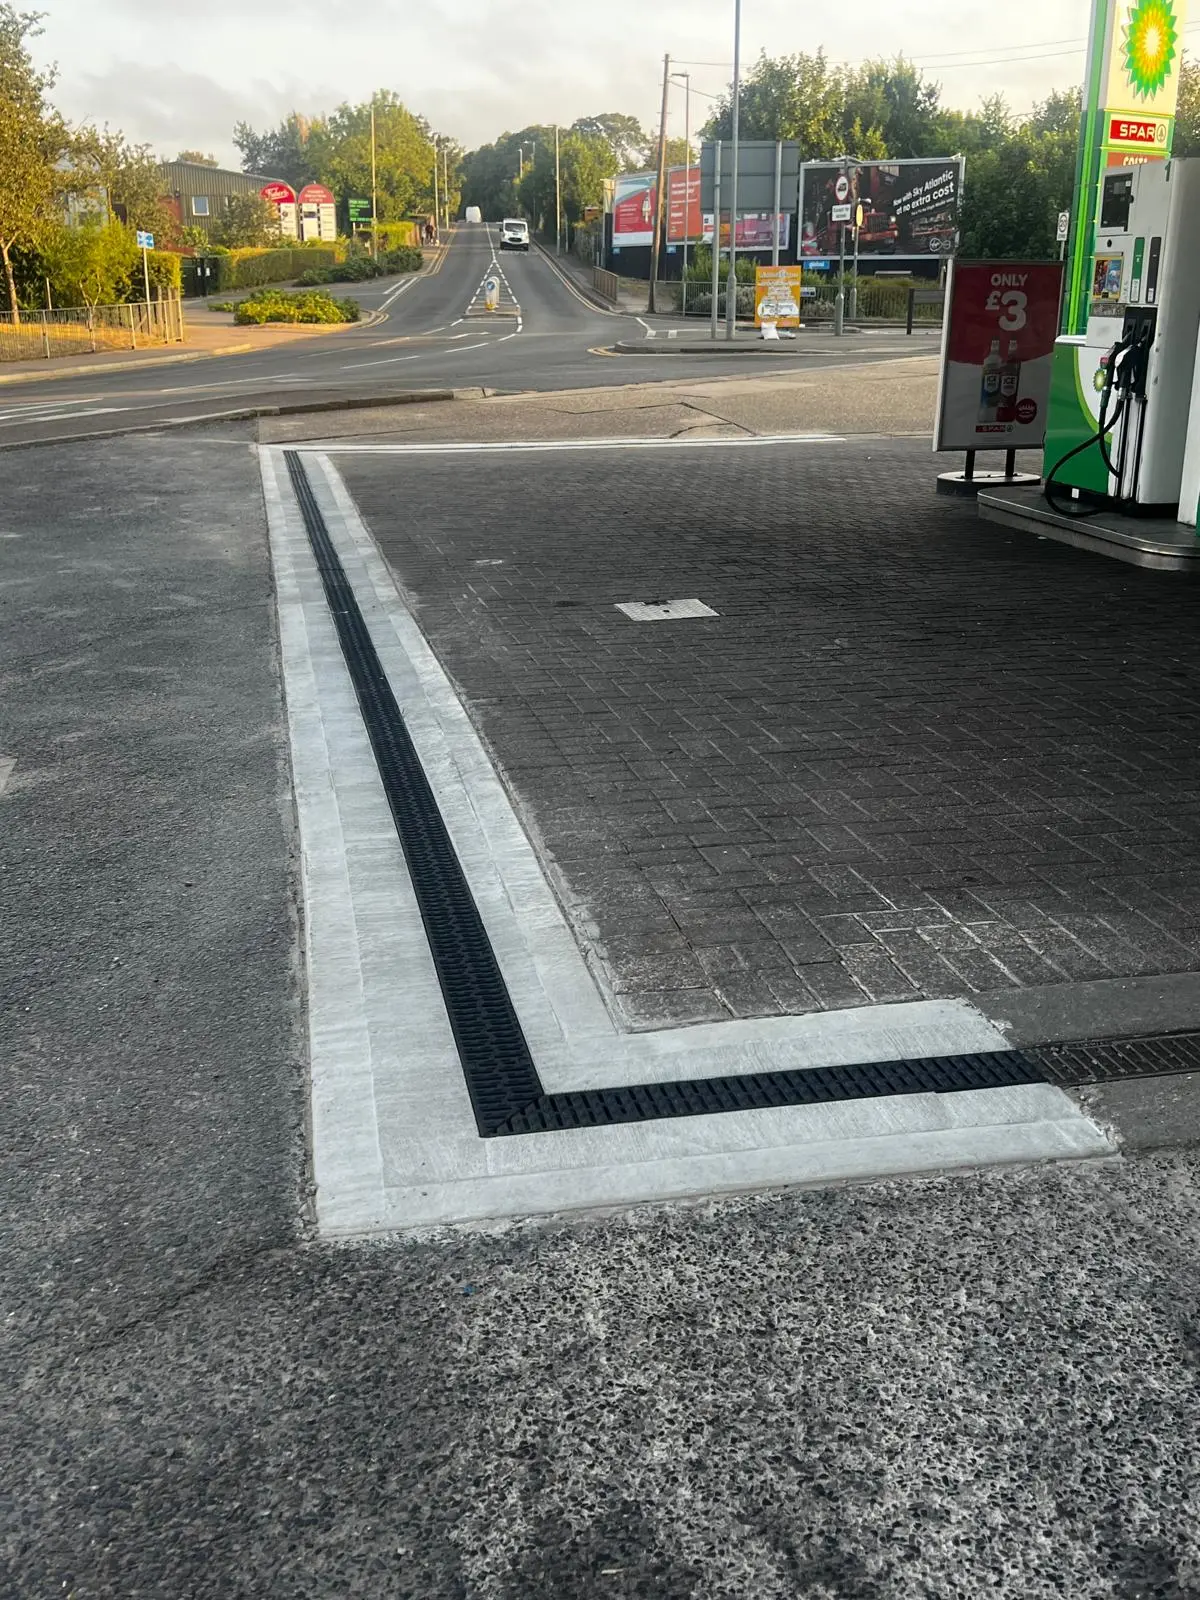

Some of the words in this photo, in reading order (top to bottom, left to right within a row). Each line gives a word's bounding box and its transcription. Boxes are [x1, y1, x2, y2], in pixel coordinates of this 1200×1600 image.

[1120, 123, 1155, 139] SPAR
[912, 186, 923, 197] Sky
[924, 170, 954, 192] Atlantic
[902, 203, 911, 213] no
[911, 194, 931, 209] extra
[932, 181, 954, 200] cost
[990, 273, 1028, 287] ONLY
[985, 290, 1028, 331] £3
[1003, 377, 1016, 385] ICE
